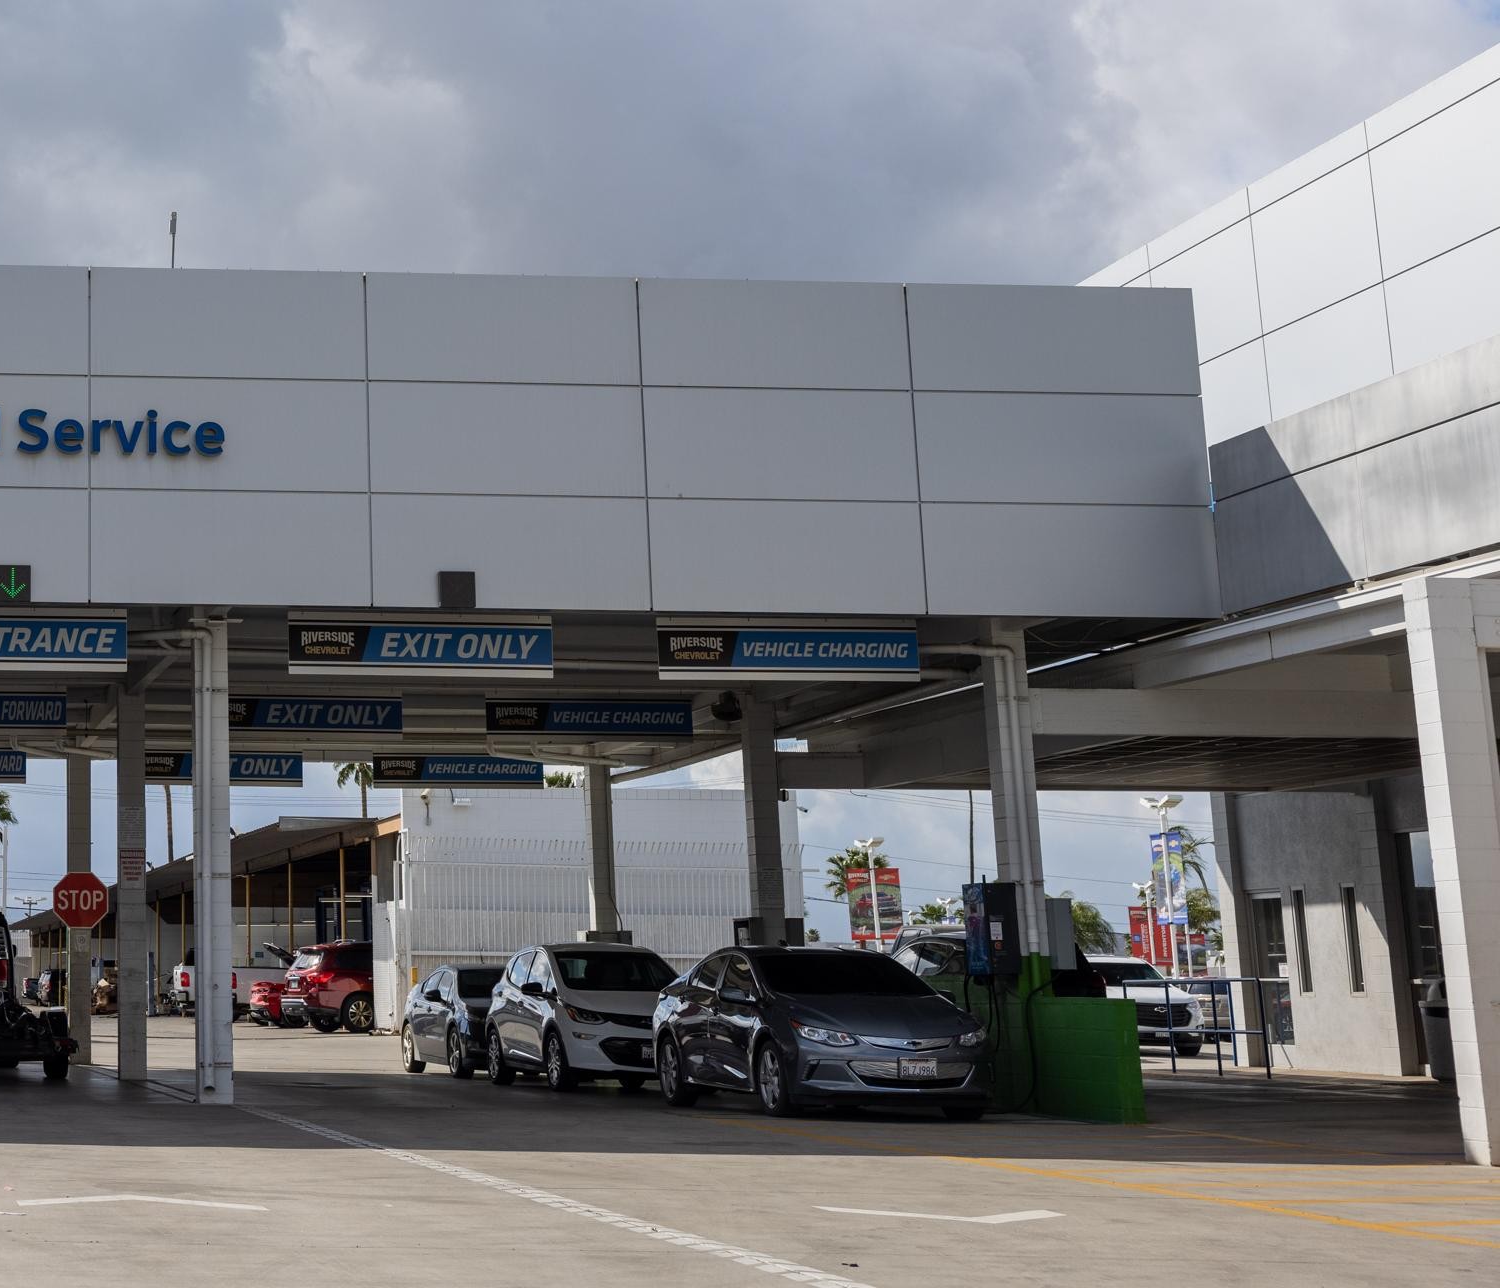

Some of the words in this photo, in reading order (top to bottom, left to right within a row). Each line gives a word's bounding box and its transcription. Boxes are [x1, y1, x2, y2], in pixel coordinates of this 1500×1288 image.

[17, 408, 225, 455] Service
[300, 631, 355, 647] RIVERSIDE
[380, 632, 453, 658] EXIT
[456, 633, 539, 660] ONLY
[670, 637, 723, 653] RIVERSIDE
[304, 646, 351, 655] CHEVROLET
[674, 651, 720, 661] CHEVROLET
[742, 641, 815, 657] VEHICLE
[818, 642, 909, 659] CHARGING
[0, 701, 63, 721] FORWARD
[266, 703, 324, 724] EXIT
[326, 704, 392, 725] ONLY
[496, 707, 538, 719] RIVERSIDE
[553, 711, 610, 724] VEHICLE
[613, 712, 684, 724] CHARGING
[240, 758, 294, 775] ONLY
[381, 760, 416, 770] RIVERSIDE
[428, 763, 475, 774] VEHICLE
[477, 763, 537, 775] CHARGING
[58, 890, 104, 910] STOP
